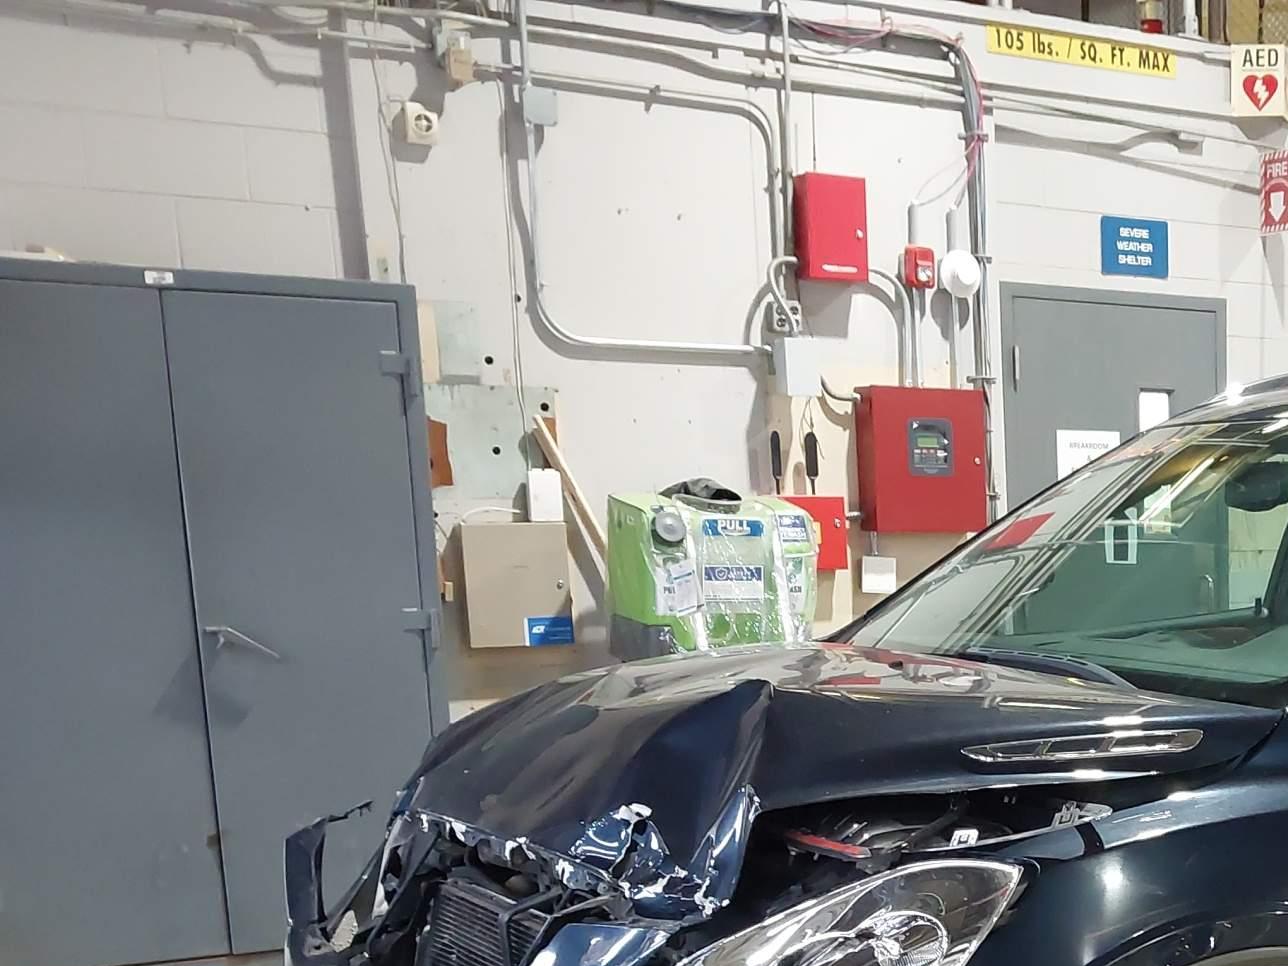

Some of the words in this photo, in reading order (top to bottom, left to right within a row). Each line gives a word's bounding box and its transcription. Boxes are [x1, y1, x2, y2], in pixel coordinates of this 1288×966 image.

[995, 28, 1025, 51] 105
[1032, 31, 1060, 57] lbs.
[1066, 37, 1073, 59] /
[1080, 41, 1104, 64] SQ.
[1111, 45, 1131, 67] FT.
[1138, 50, 1171, 73] MAX
[1242, 48, 1279, 67] AED
[1266, 161, 1288, 179] FIRE
[1119, 226, 1150, 239] SEVERE
[1116, 240, 1153, 253] WEATHER
[1118, 254, 1153, 266] SHELTER
[1069, 442, 1109, 450] BREAKROOM
[718, 518, 751, 531] PULL
